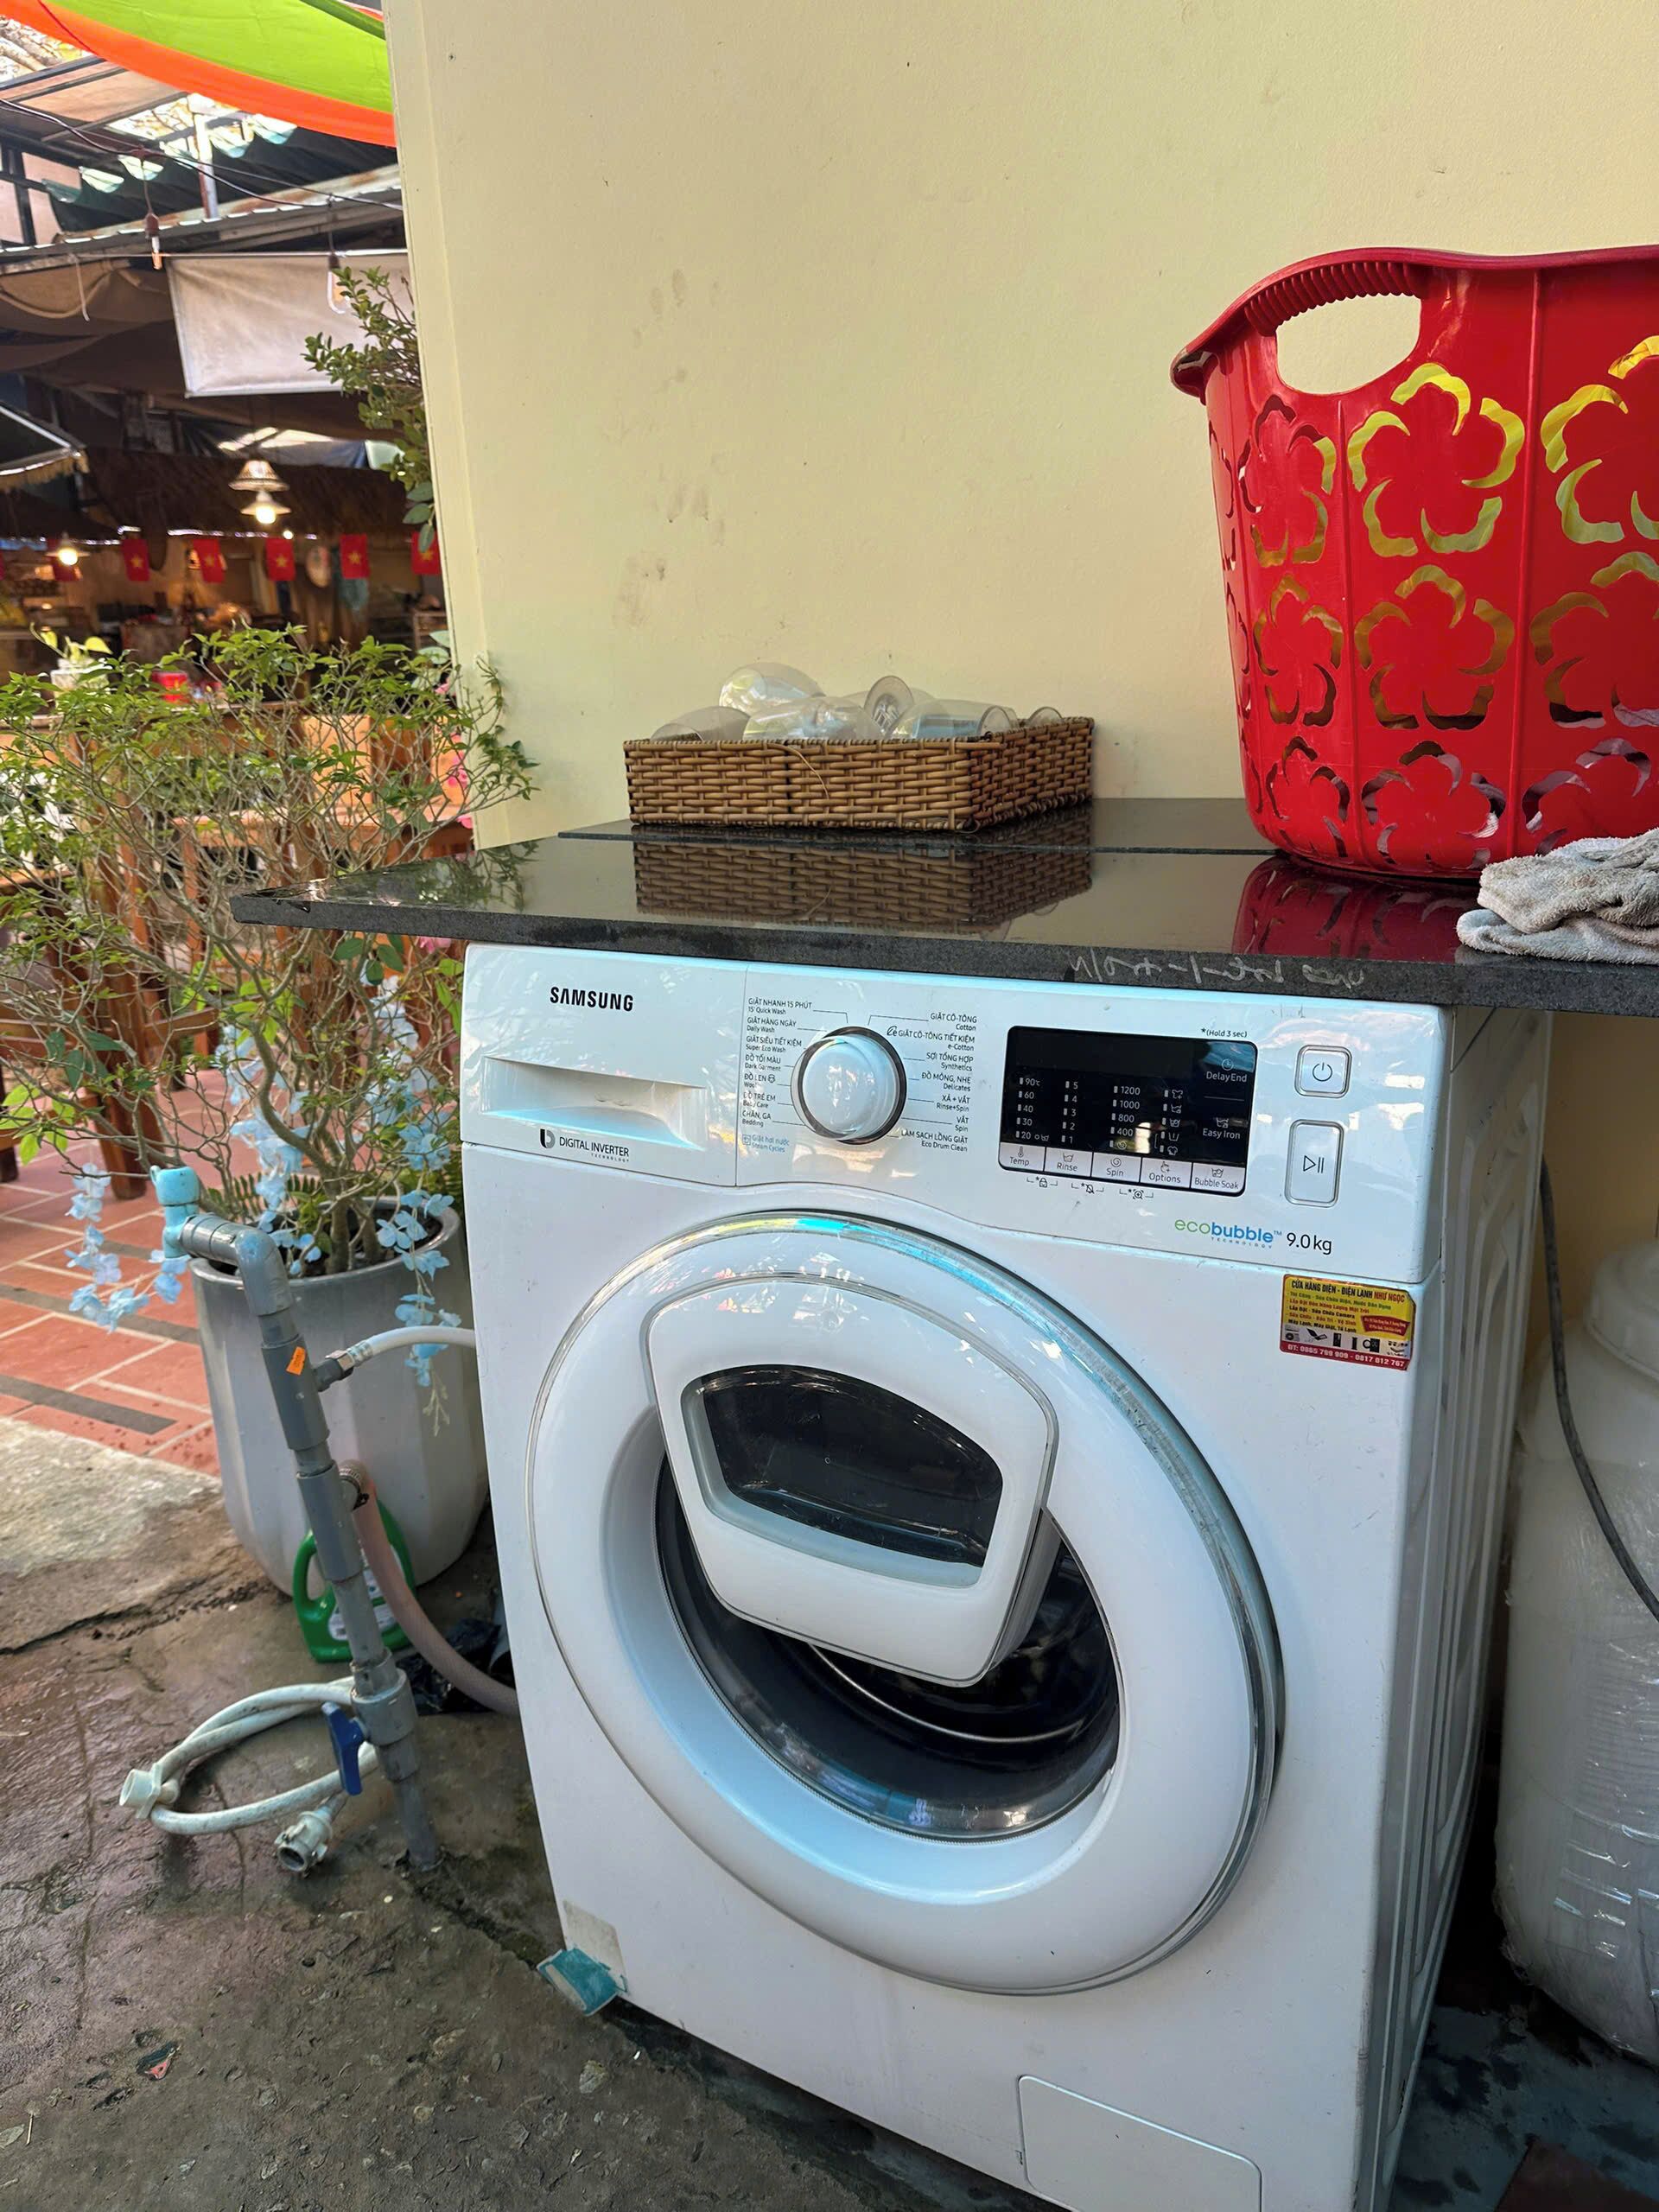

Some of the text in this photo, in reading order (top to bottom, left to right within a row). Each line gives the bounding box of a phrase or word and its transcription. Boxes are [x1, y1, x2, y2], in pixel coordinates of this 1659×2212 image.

[550, 986, 634, 1012] SAMSUNG
[795, 1001, 812, 1009] PHÚT
[780, 1019, 797, 1027] NGÀY
[760, 1036, 773, 1045] SIÊU
[947, 1043, 974, 1052] e-Cotton
[745, 1053, 754, 1062] ĐỒ
[766, 1054, 781, 1064] MÀU
[941, 1062, 972, 1071] Synthetics
[744, 1071, 754, 1080] ĐỒ
[921, 1070, 931, 1079] ĐỒ
[1206, 1071, 1248, 1083] Delay End
[944, 1083, 971, 1092] Delicates
[1073, 1081, 1078, 1090] 5
[1024, 1091, 1034, 1100] 60
[1121, 1086, 1141, 1096] 1200
[1071, 1095, 1077, 1103] 4
[936, 1103, 969, 1112] Rinse+Spin
[1023, 1104, 1033, 1113] 40
[1120, 1100, 1141, 1109] 1000
[1071, 1109, 1077, 1117] 3
[1118, 1114, 1135, 1123] 800
[742, 1119, 764, 1128] Bedding
[1070, 1122, 1076, 1131] 2
[955, 1124, 969, 1133] Spin
[1116, 1128, 1134, 1137] 400
[1020, 1131, 1032, 1140] 20
[1203, 1128, 1241, 1141] Easy Iron
[559, 1136, 629, 1157] DIGITAL INVERTER
[769, 1144, 785, 1153] Cycles
[933, 1141, 950, 1150] Drum
[591, 1153, 629, 1163] TECHNOLOGY
[1009, 1156, 1030, 1167] Temp
[1057, 1162, 1077, 1172] Rinse
[1106, 1168, 1124, 1177] Spin
[1148, 1173, 1181, 1184] Options
[1194, 1177, 1239, 1190] Bubble Soak
[1211, 1236, 1273, 1249] TECHNOLOGY
[1286, 1232, 1311, 1249] 9.0
[1313, 1235, 1332, 1255] kg
